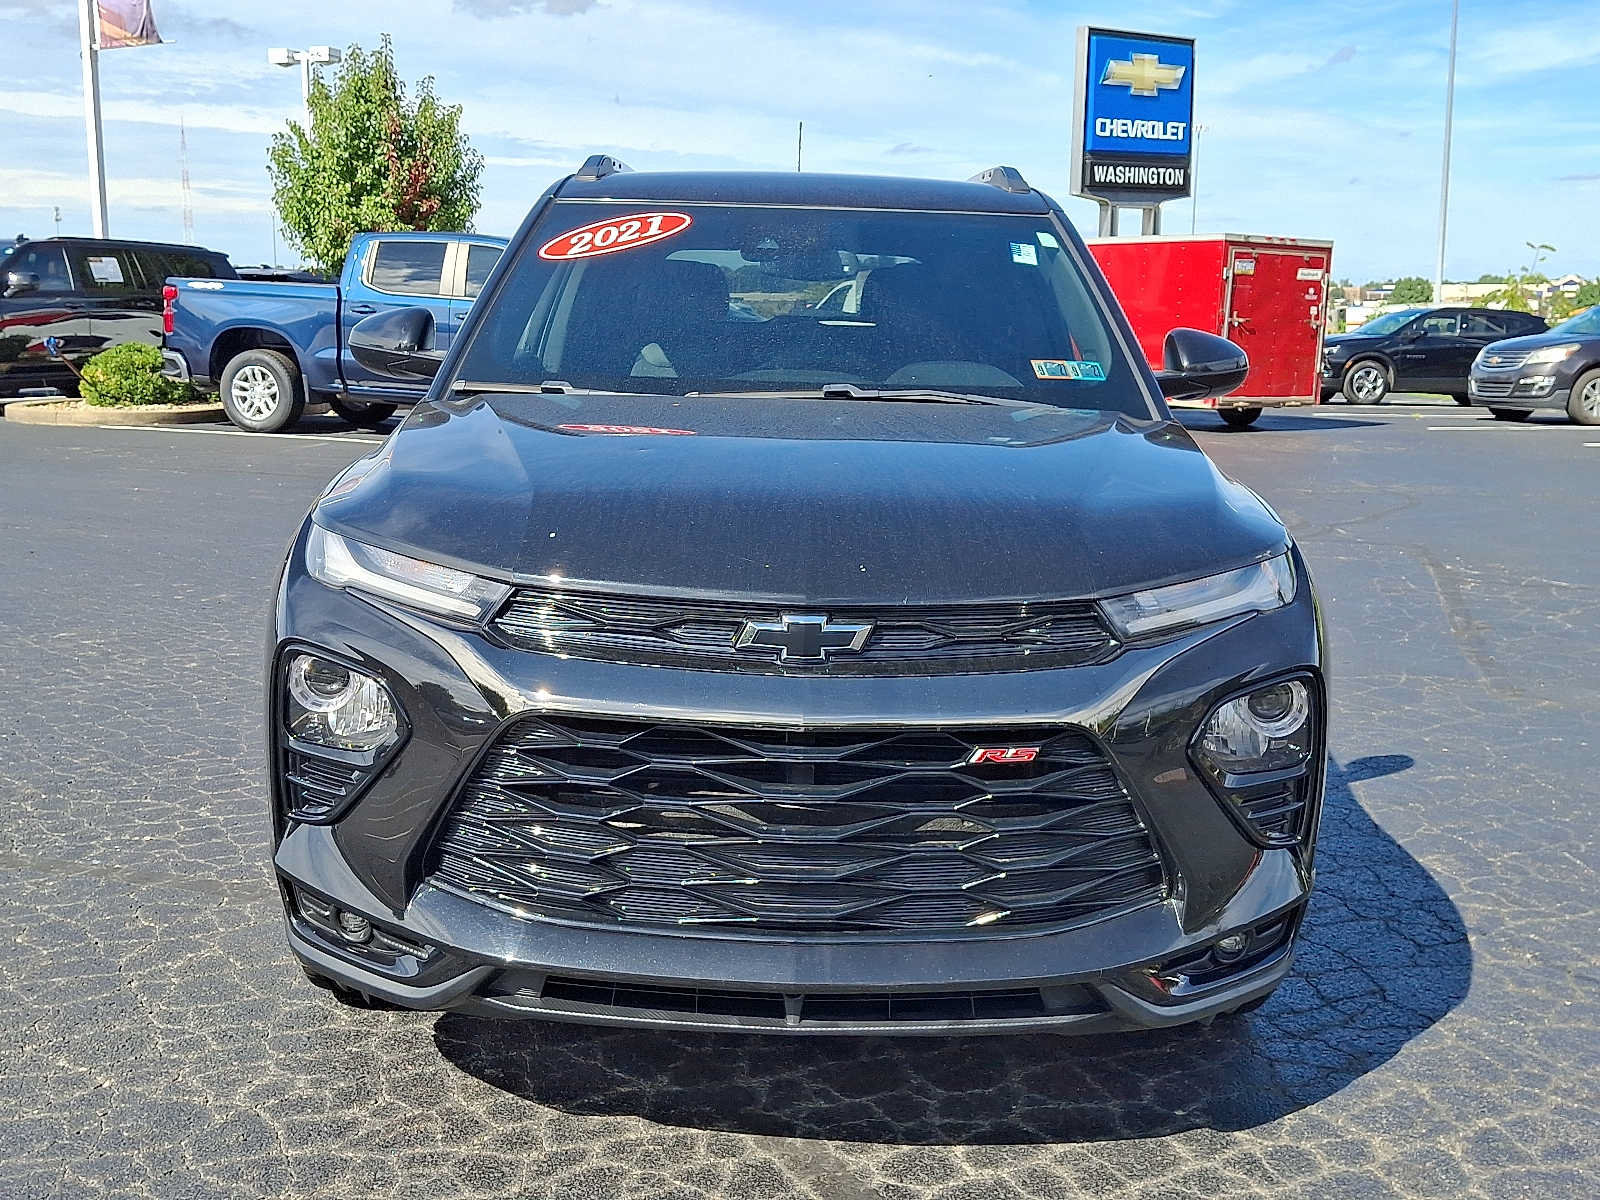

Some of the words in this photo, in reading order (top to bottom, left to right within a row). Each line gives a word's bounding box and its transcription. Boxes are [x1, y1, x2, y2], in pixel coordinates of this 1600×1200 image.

[1095, 117, 1187, 141] CHEVROLET
[1093, 164, 1185, 186] WASHINGTON
[566, 215, 664, 256] 2021
[969, 747, 1040, 764] RS
